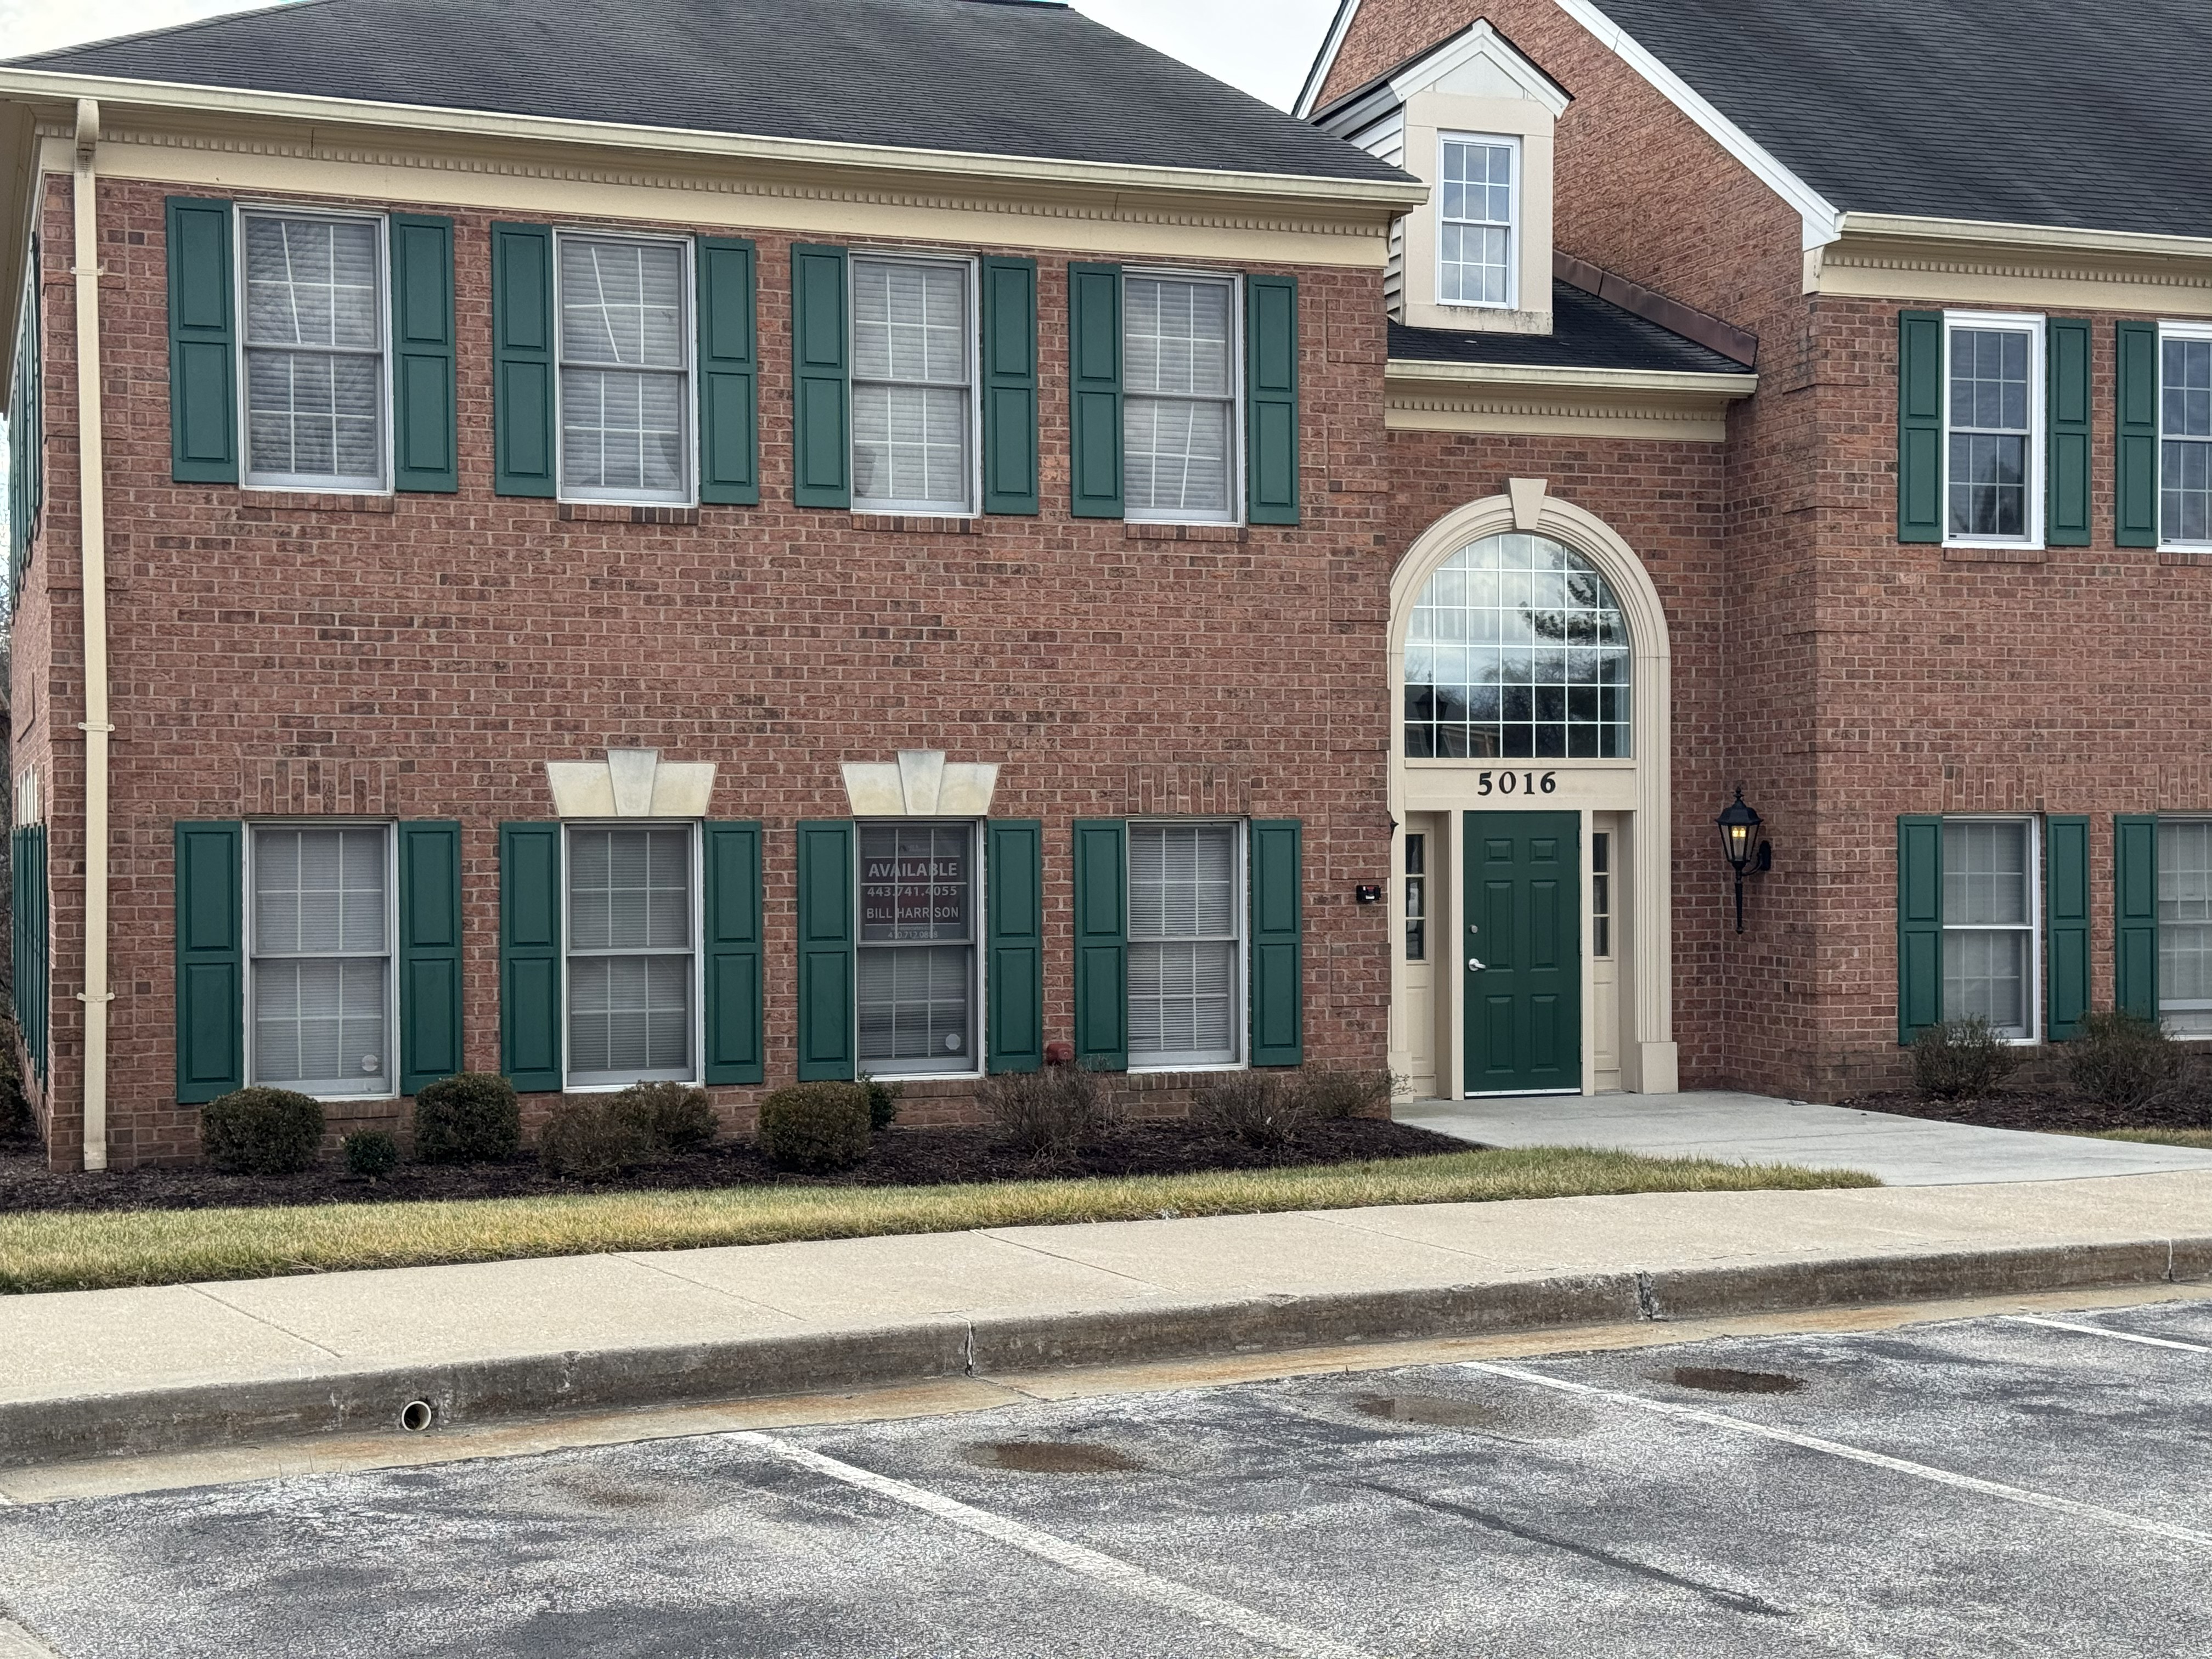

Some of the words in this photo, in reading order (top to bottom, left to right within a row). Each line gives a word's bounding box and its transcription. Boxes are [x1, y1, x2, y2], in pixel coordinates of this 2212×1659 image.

[1477, 771, 1556, 795] 5016
[868, 862, 957, 877] AVAILABLE
[867, 886, 957, 896] 443.741.4055
[867, 908, 893, 918] BILL
[896, 907, 958, 918] HARRSON
